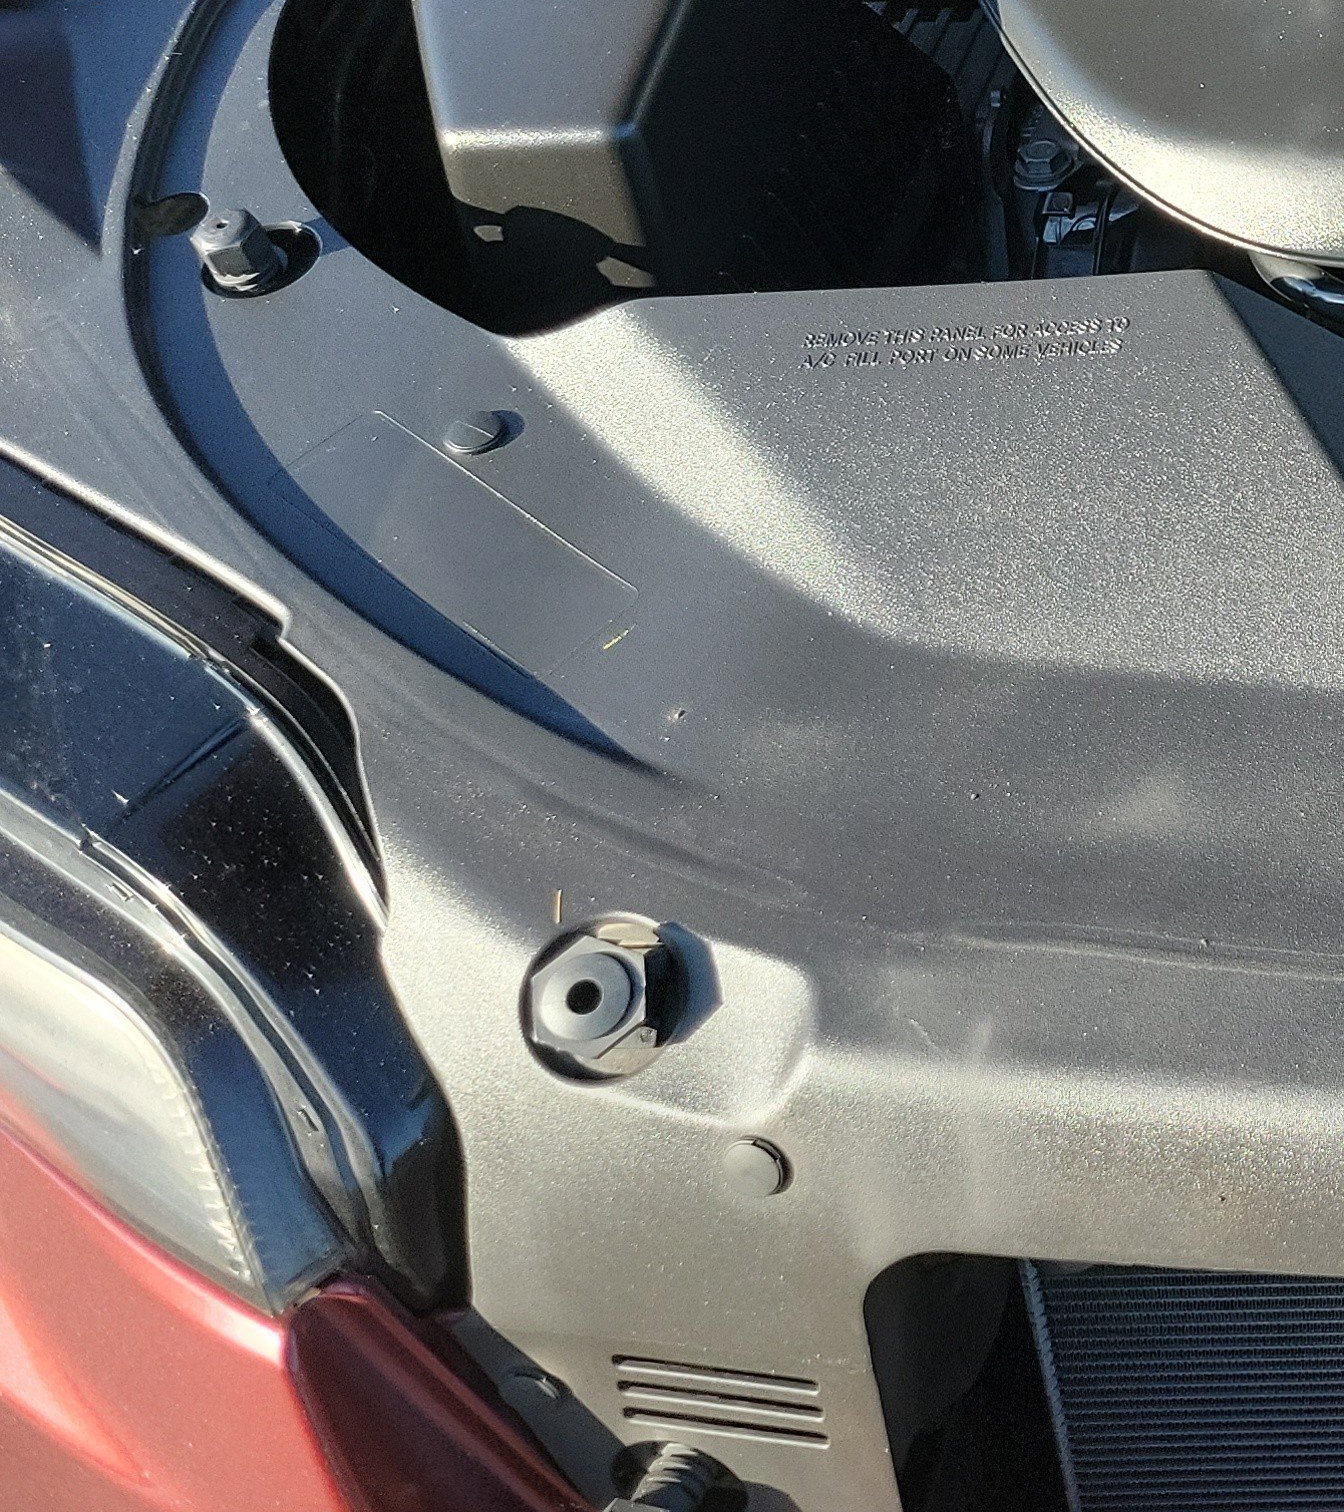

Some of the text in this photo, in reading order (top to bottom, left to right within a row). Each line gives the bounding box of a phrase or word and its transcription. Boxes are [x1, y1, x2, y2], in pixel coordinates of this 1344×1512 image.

[802, 316, 1130, 349] REMOVE THIS PANEL FOR ACCESS TO
[798, 338, 1124, 370] A/C FILL PORT ON SOME VEHICLES
